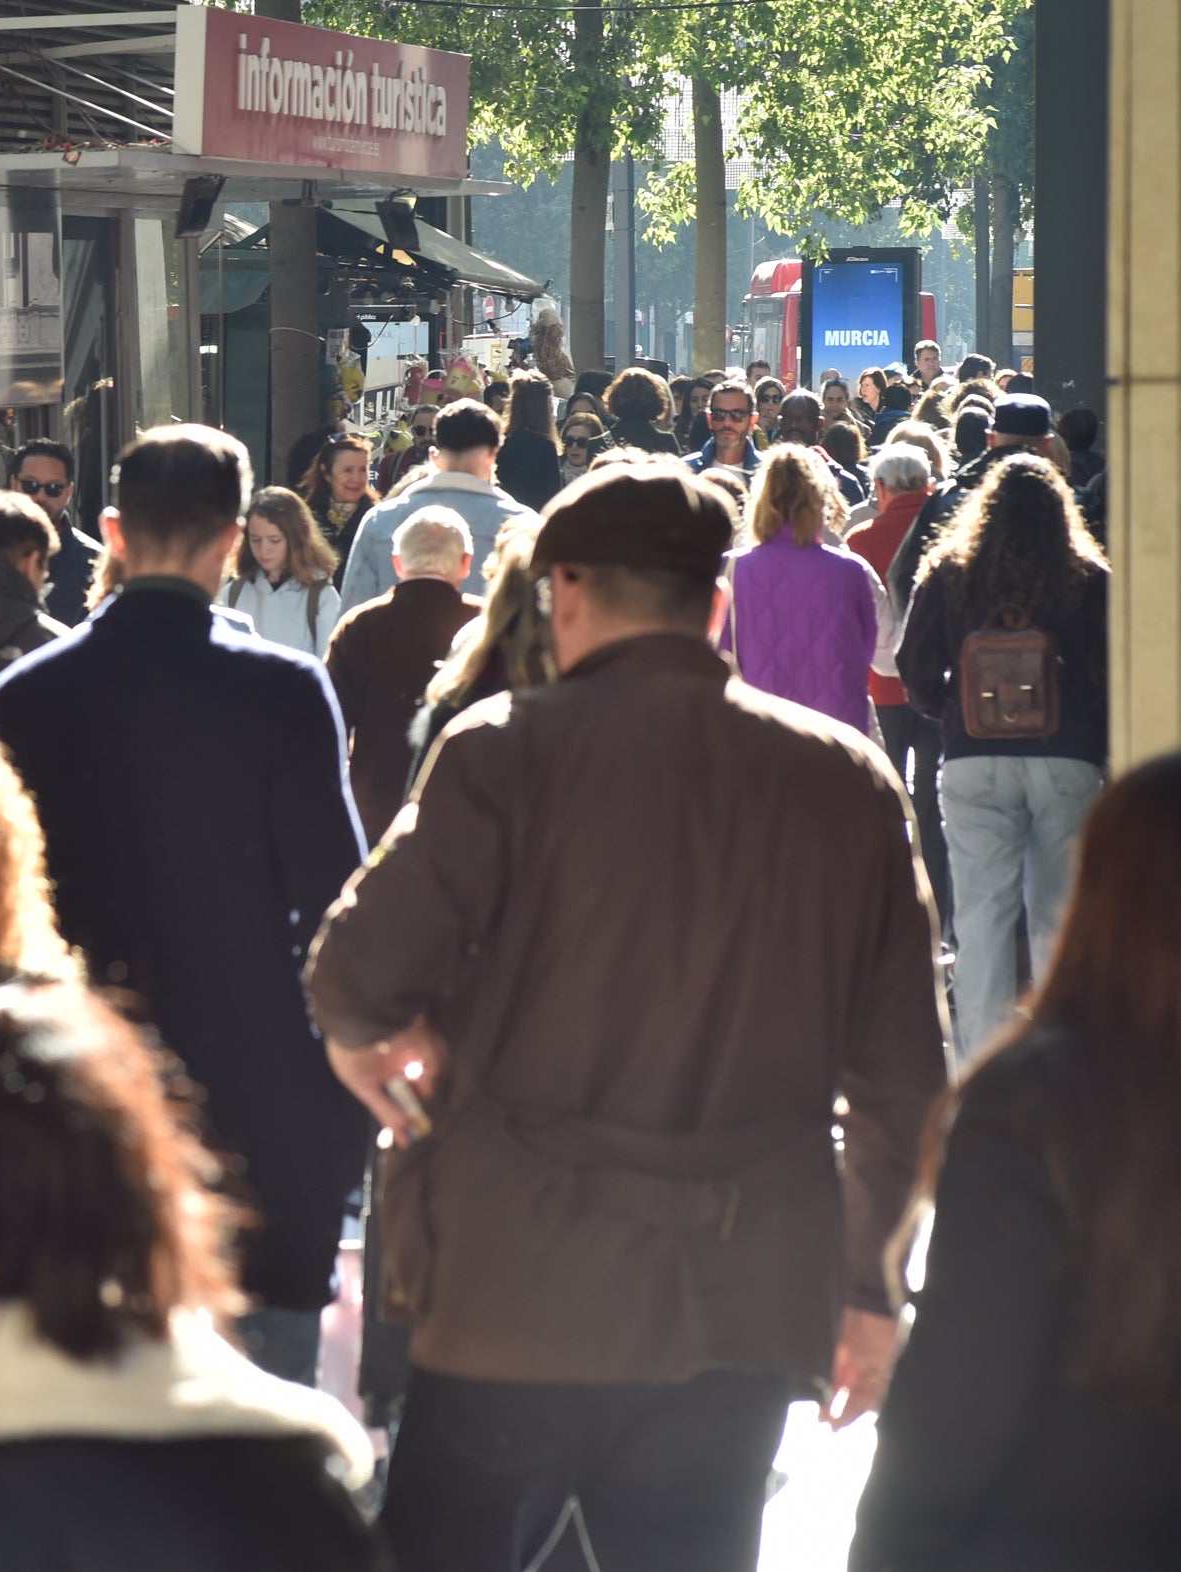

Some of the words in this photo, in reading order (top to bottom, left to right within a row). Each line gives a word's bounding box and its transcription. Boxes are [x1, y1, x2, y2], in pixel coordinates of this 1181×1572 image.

[238, 33, 368, 125] información
[371, 60, 447, 136] turística
[824, 329, 890, 346] MURCIA
